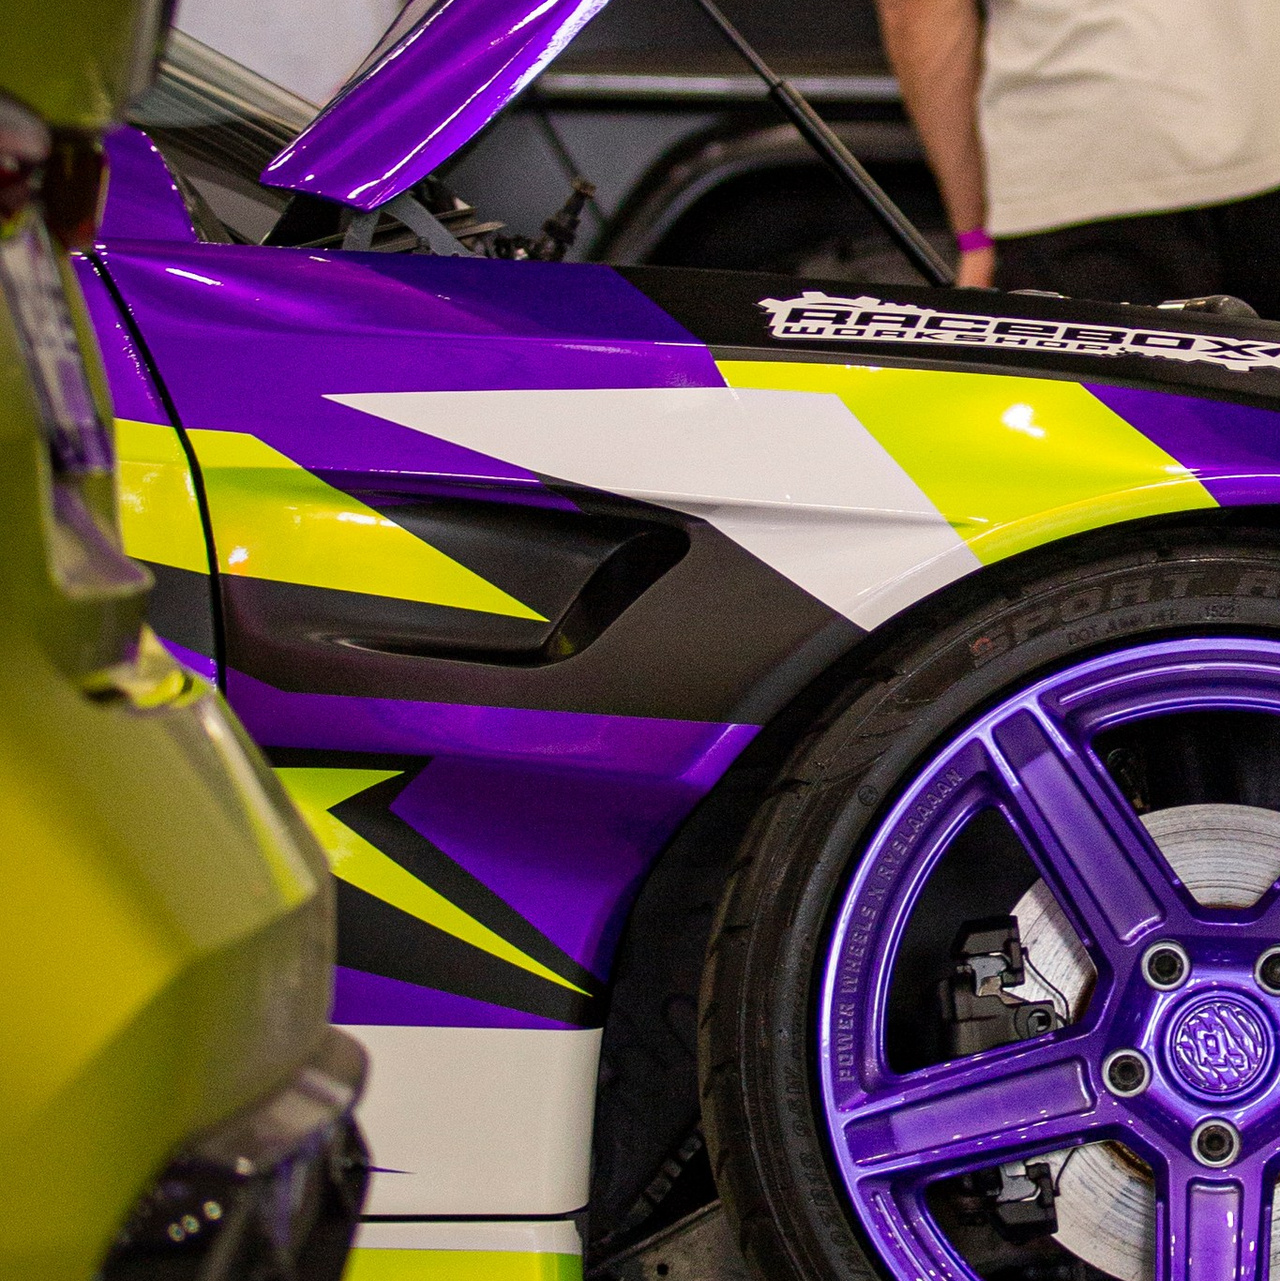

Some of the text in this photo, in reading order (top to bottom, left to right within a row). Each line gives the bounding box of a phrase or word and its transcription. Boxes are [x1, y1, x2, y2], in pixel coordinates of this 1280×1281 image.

[780, 325, 1112, 351] WORKSHOP
[785, 306, 1266, 359] RACEBOX
[841, 904, 876, 995] WHEELS
[837, 1001, 855, 1082] POWER
